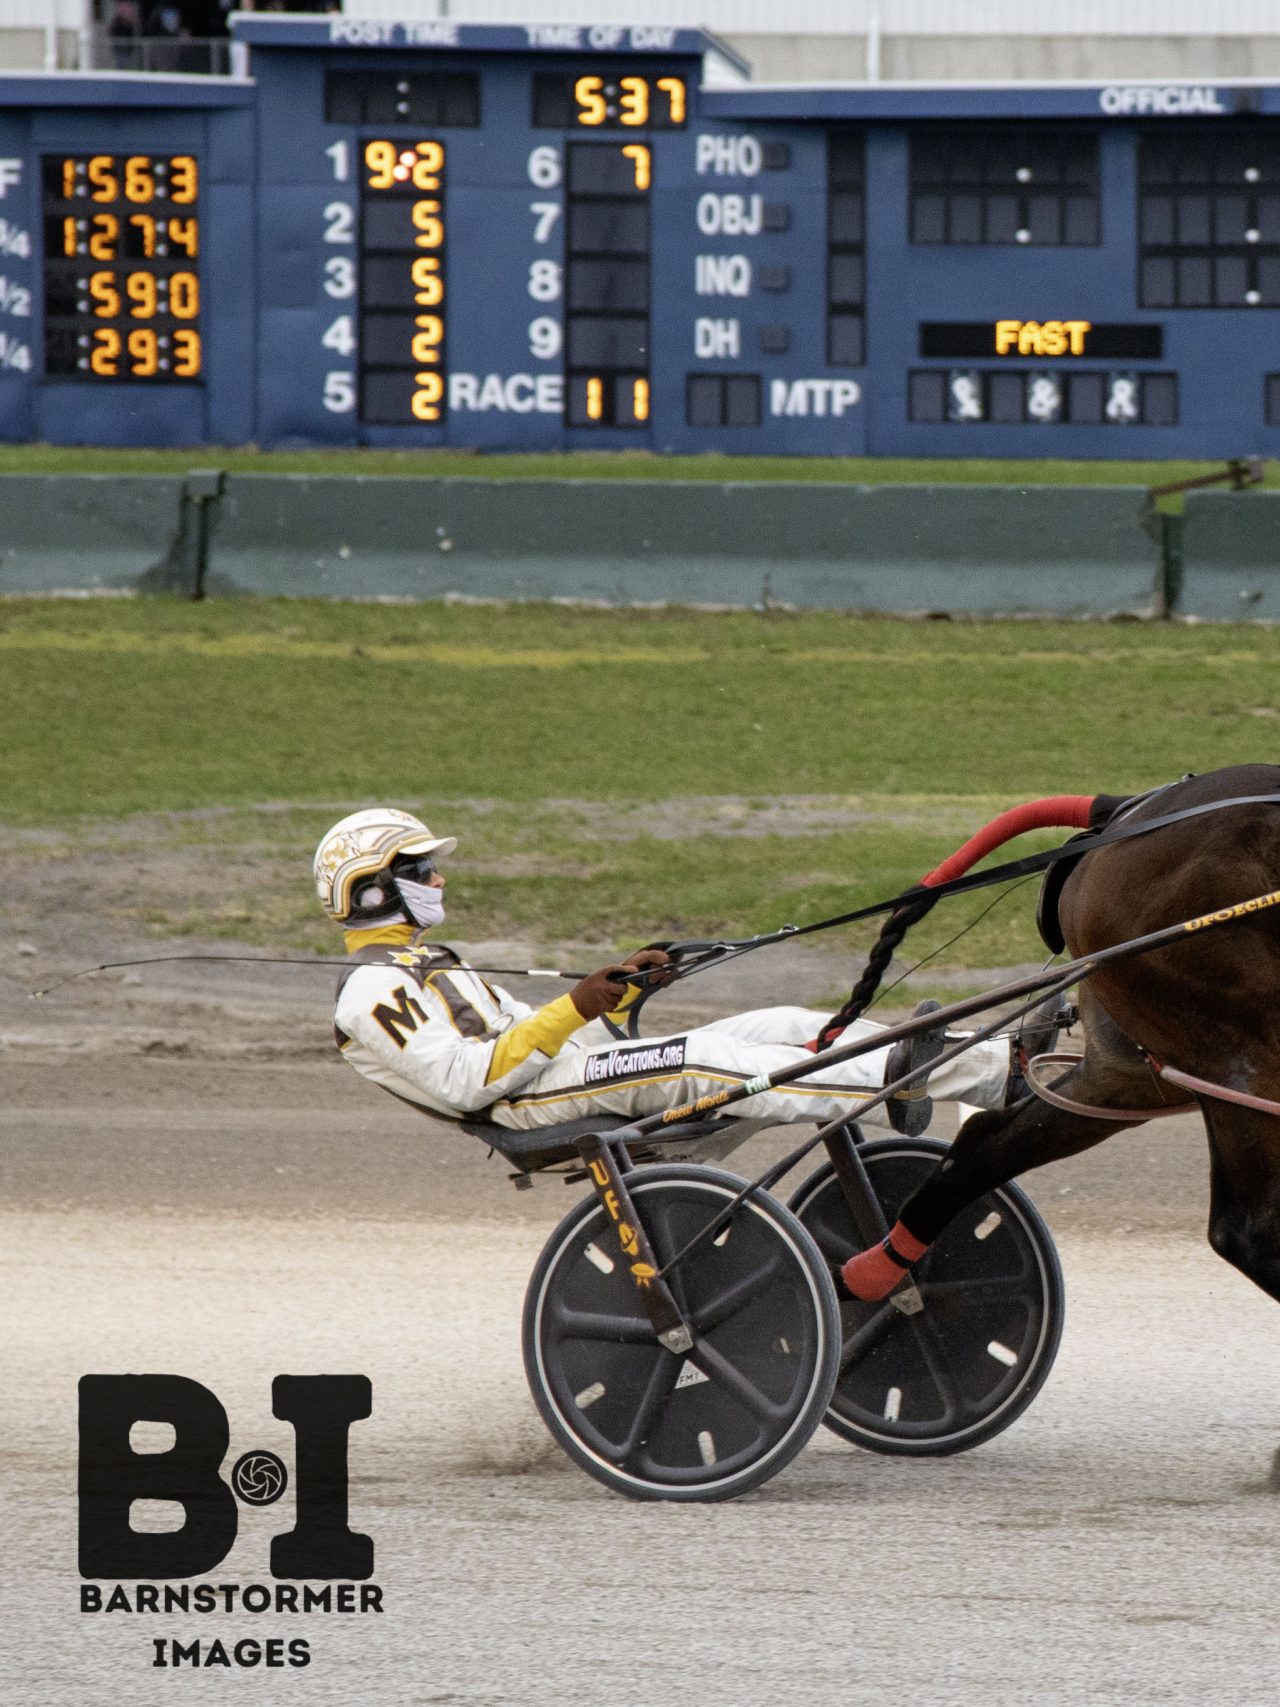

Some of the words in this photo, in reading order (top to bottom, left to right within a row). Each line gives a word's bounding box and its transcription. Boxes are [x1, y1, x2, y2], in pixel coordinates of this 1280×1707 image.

[330, 23, 391, 44] POST
[404, 24, 458, 46] TIME
[527, 27, 580, 48] TIME
[589, 28, 617, 48] OF
[630, 29, 675, 49] DAY
[575, 77, 687, 127] 5:37
[1100, 87, 1224, 114] OFFICIAL
[328, 142, 349, 182] 1
[529, 147, 562, 189] 6
[622, 145, 652, 192] 7
[697, 135, 762, 178] PHO
[325, 202, 354, 244] 2
[412, 200, 445, 250] 5
[532, 203, 561, 244] 7
[698, 194, 763, 236] OBJ
[325, 258, 356, 300] 3
[412, 257, 445, 307] 5
[529, 260, 563, 303] 8
[697, 256, 752, 297] INQ
[323, 316, 356, 357] 4
[412, 315, 445, 365] 2
[530, 318, 563, 360] 9
[696, 319, 740, 359] DH
[996, 320, 1092, 357] FAST
[325, 372, 356, 414] 5
[412, 372, 445, 422] 2
[450, 374, 564, 414] RACE
[587, 378, 651, 422] 11
[772, 380, 861, 417] MTP
[1184, 908, 1233, 932] UFO
[371, 985, 430, 1050] M
[585, 1044, 684, 1083] NEWVOCATIONS.ORG
